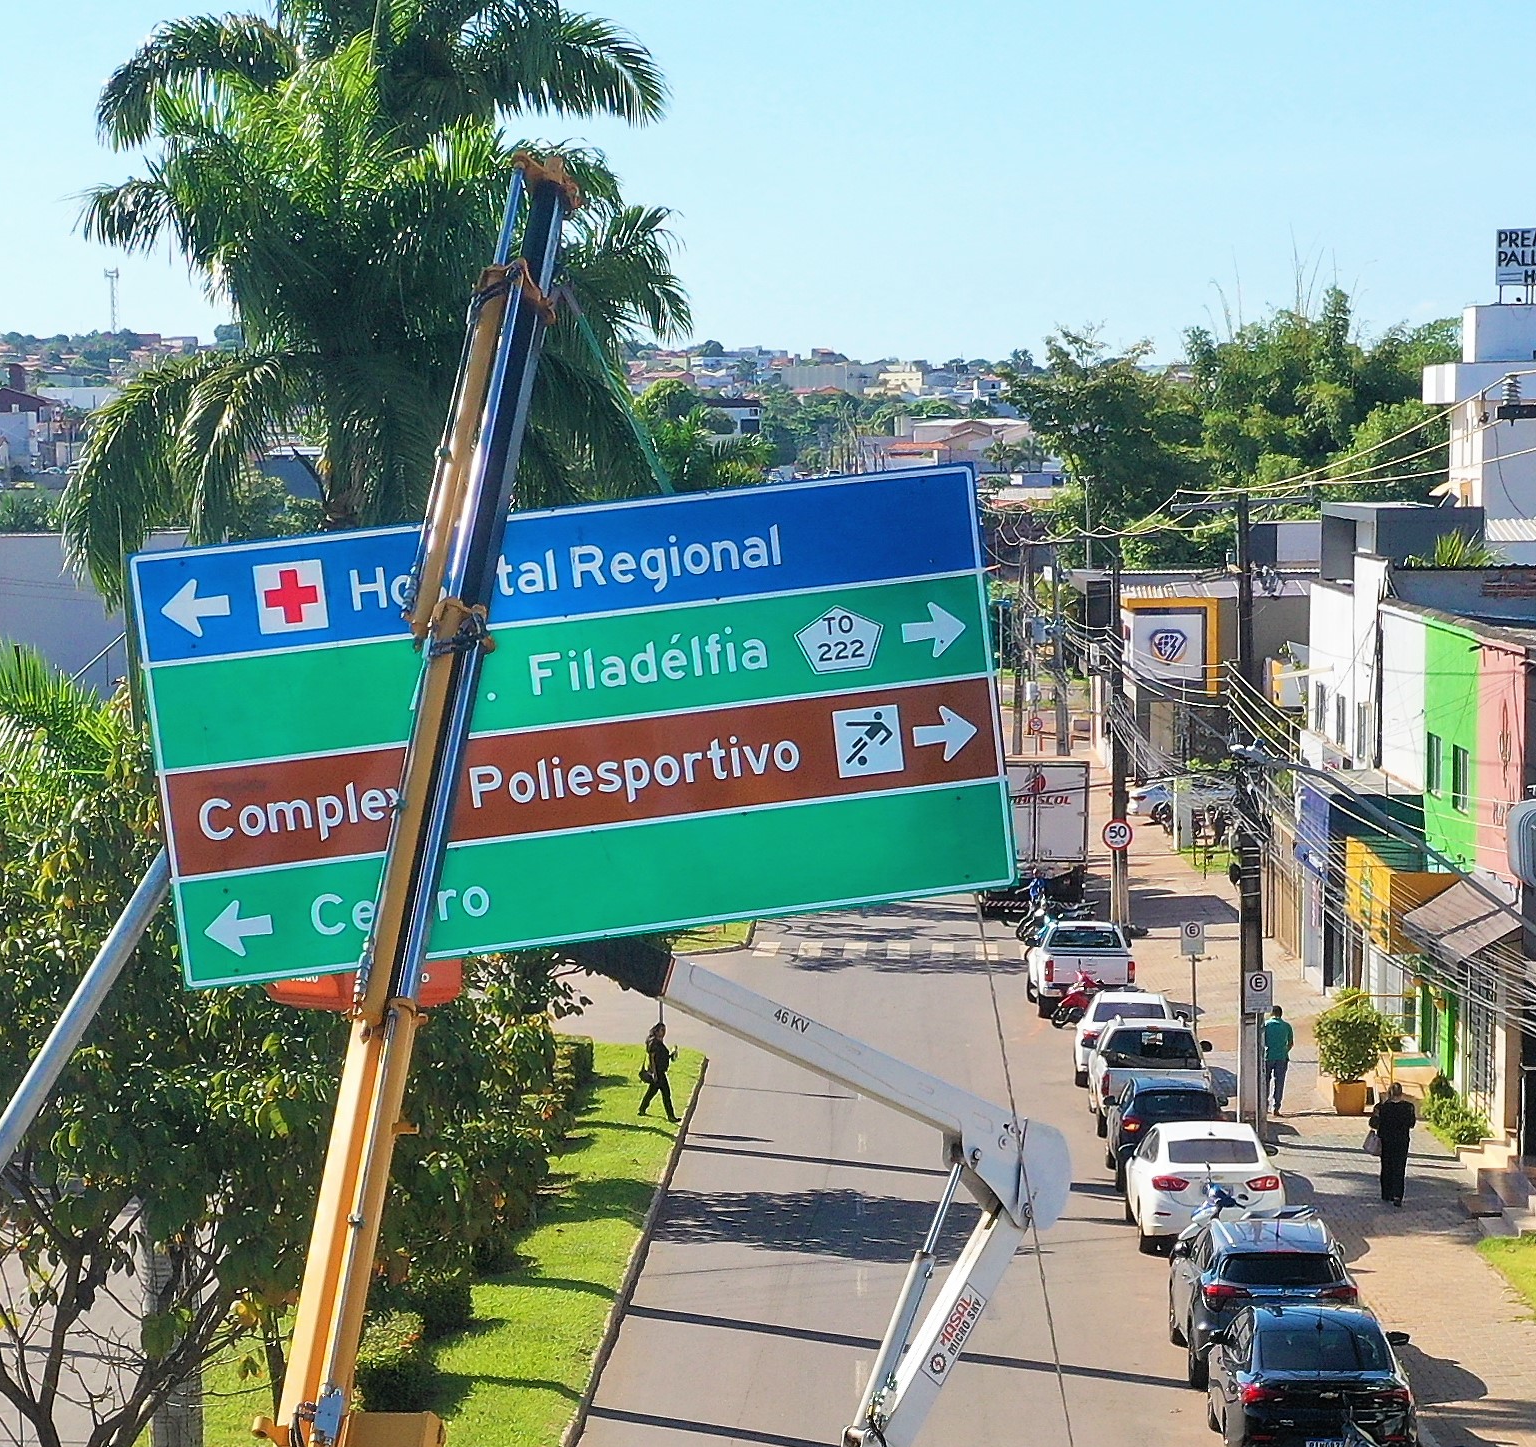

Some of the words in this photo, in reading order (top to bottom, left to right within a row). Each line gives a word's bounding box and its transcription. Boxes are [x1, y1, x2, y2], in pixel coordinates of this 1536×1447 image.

[349, 549, 558, 612] Hotal
[569, 523, 782, 593] Regional
[822, 615, 854, 635] TO
[528, 626, 769, 696] Filadélfia
[817, 639, 865, 662] 222
[468, 735, 800, 809] Poliesportivo
[1108, 825, 1127, 839] 50
[310, 886, 490, 936] Cero
[1254, 977, 1263, 988] E
[773, 1008, 790, 1025] 46
[790, 1015, 810, 1033] KV
[939, 1294, 973, 1347] MASAL
[947, 1319, 971, 1356] MICRO
[966, 1297, 982, 1321] SKY
